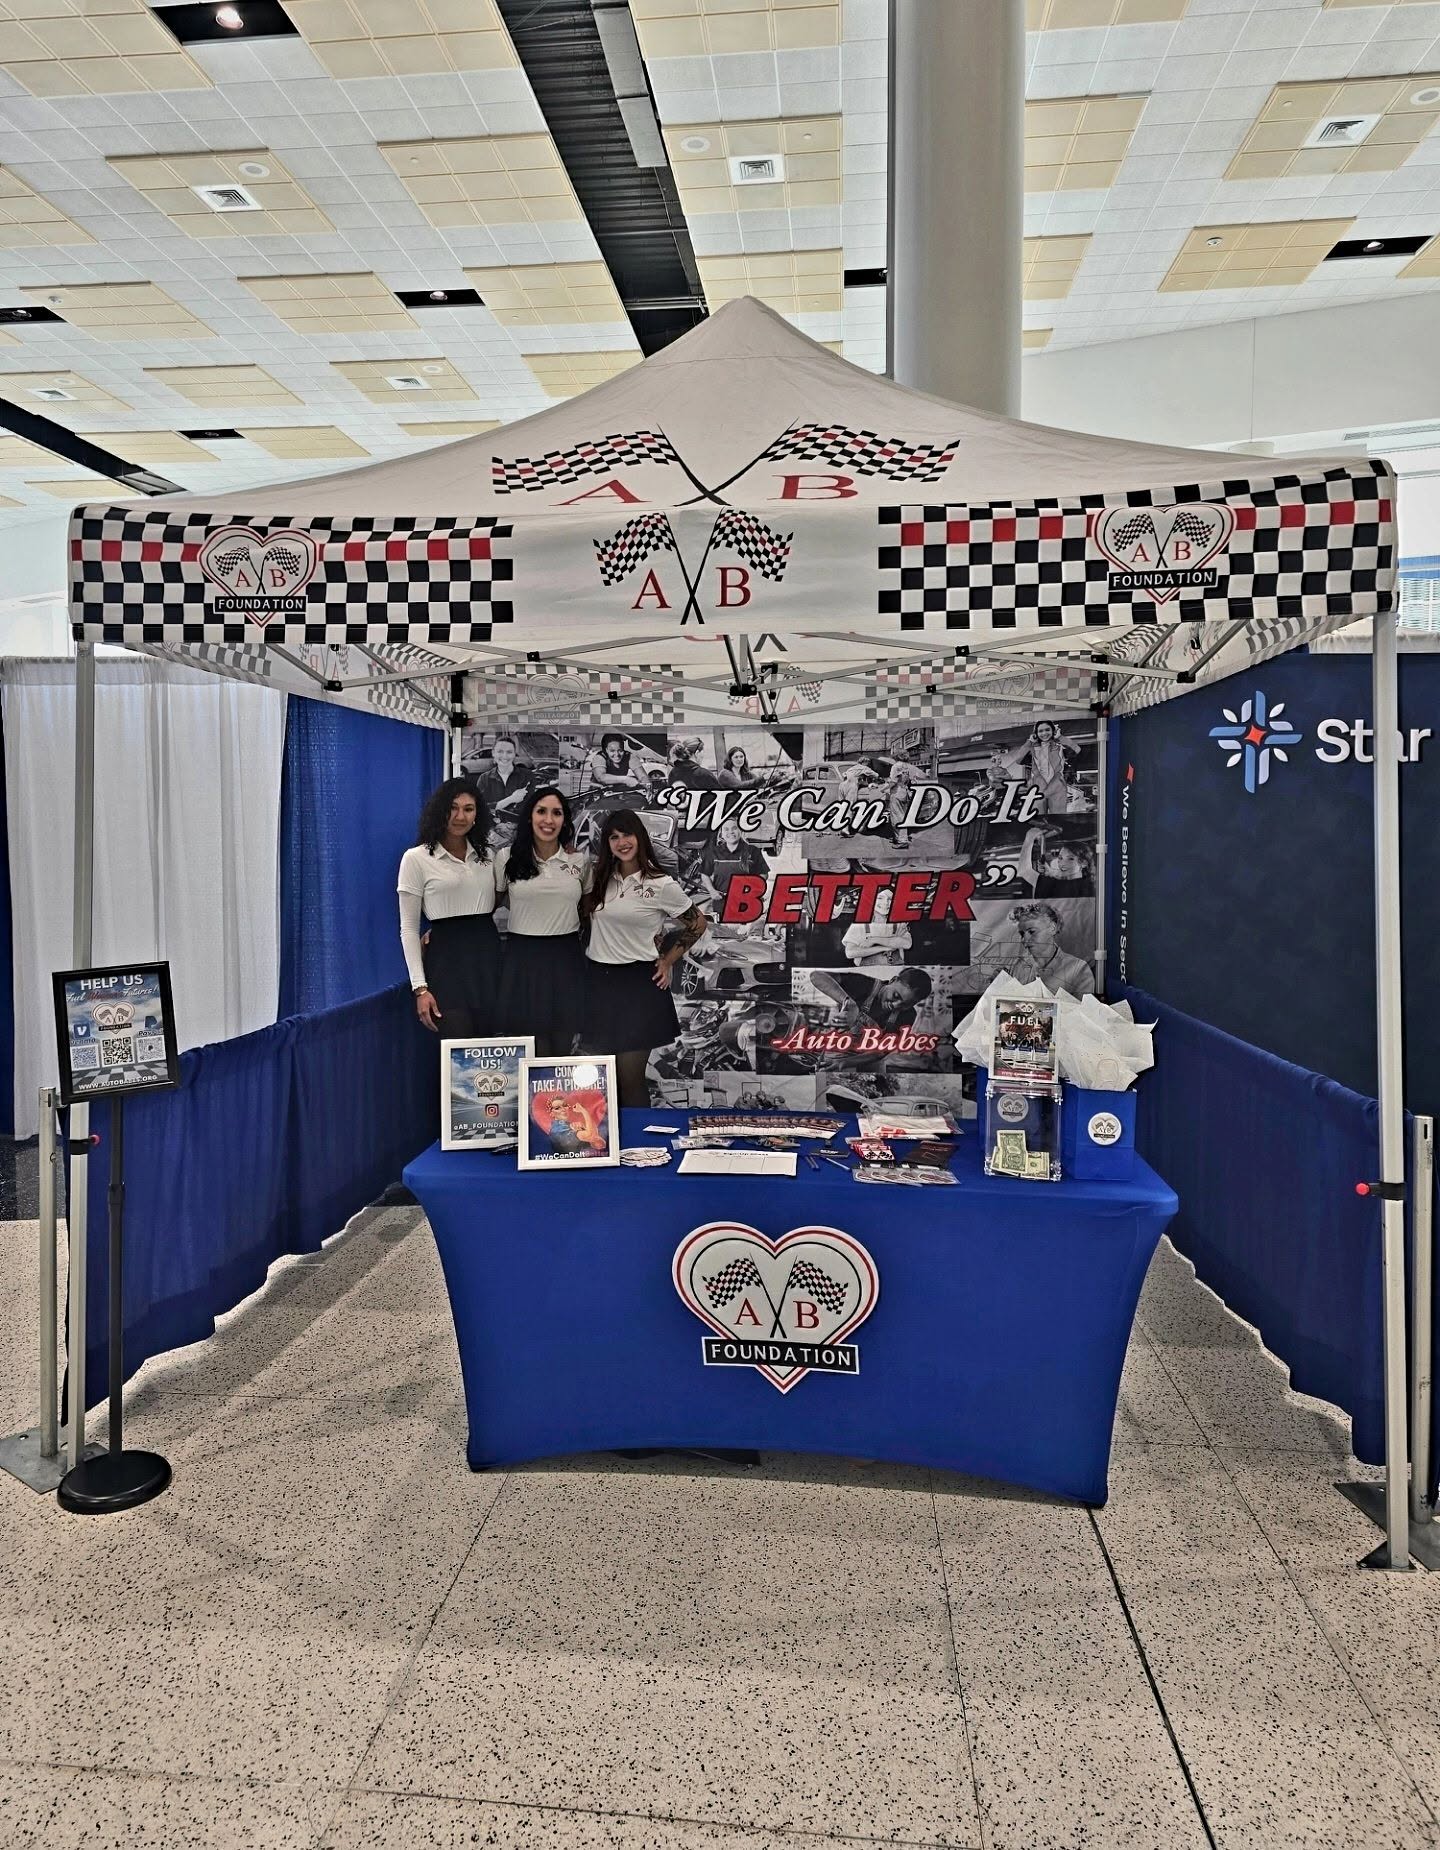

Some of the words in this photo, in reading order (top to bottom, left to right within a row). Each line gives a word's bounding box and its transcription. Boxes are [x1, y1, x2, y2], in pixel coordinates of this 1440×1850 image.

[548, 479, 653, 507] A
[766, 474, 859, 501] B
[1130, 542, 1151, 563] A
[1173, 540, 1192, 561] B
[235, 568, 253, 588] A
[269, 568, 287, 588] B
[631, 567, 672, 610] A
[715, 566, 752, 608] B
[1112, 571, 1214, 588] FOUNDATION
[218, 598, 304, 610] FOUNDATION
[777, 786, 886, 832] Can
[897, 783, 981, 829] Do
[989, 779, 1044, 825] It
[1122, 785, 1129, 820] We
[1121, 826, 1129, 904] Believe
[80, 976, 119, 991] HELP
[123, 974, 144, 986] US
[1009, 1015, 1040, 1026] FUEL
[857, 1025, 939, 1052] Babes
[464, 1046, 517, 1058] FOLLOW
[480, 1058, 502, 1070] US!
[532, 1079, 555, 1093] TAKE
[556, 1079, 563, 1092] A
[733, 1297, 763, 1326] A
[792, 1300, 820, 1329] B
[711, 1344, 851, 1366] FOUNDATION
